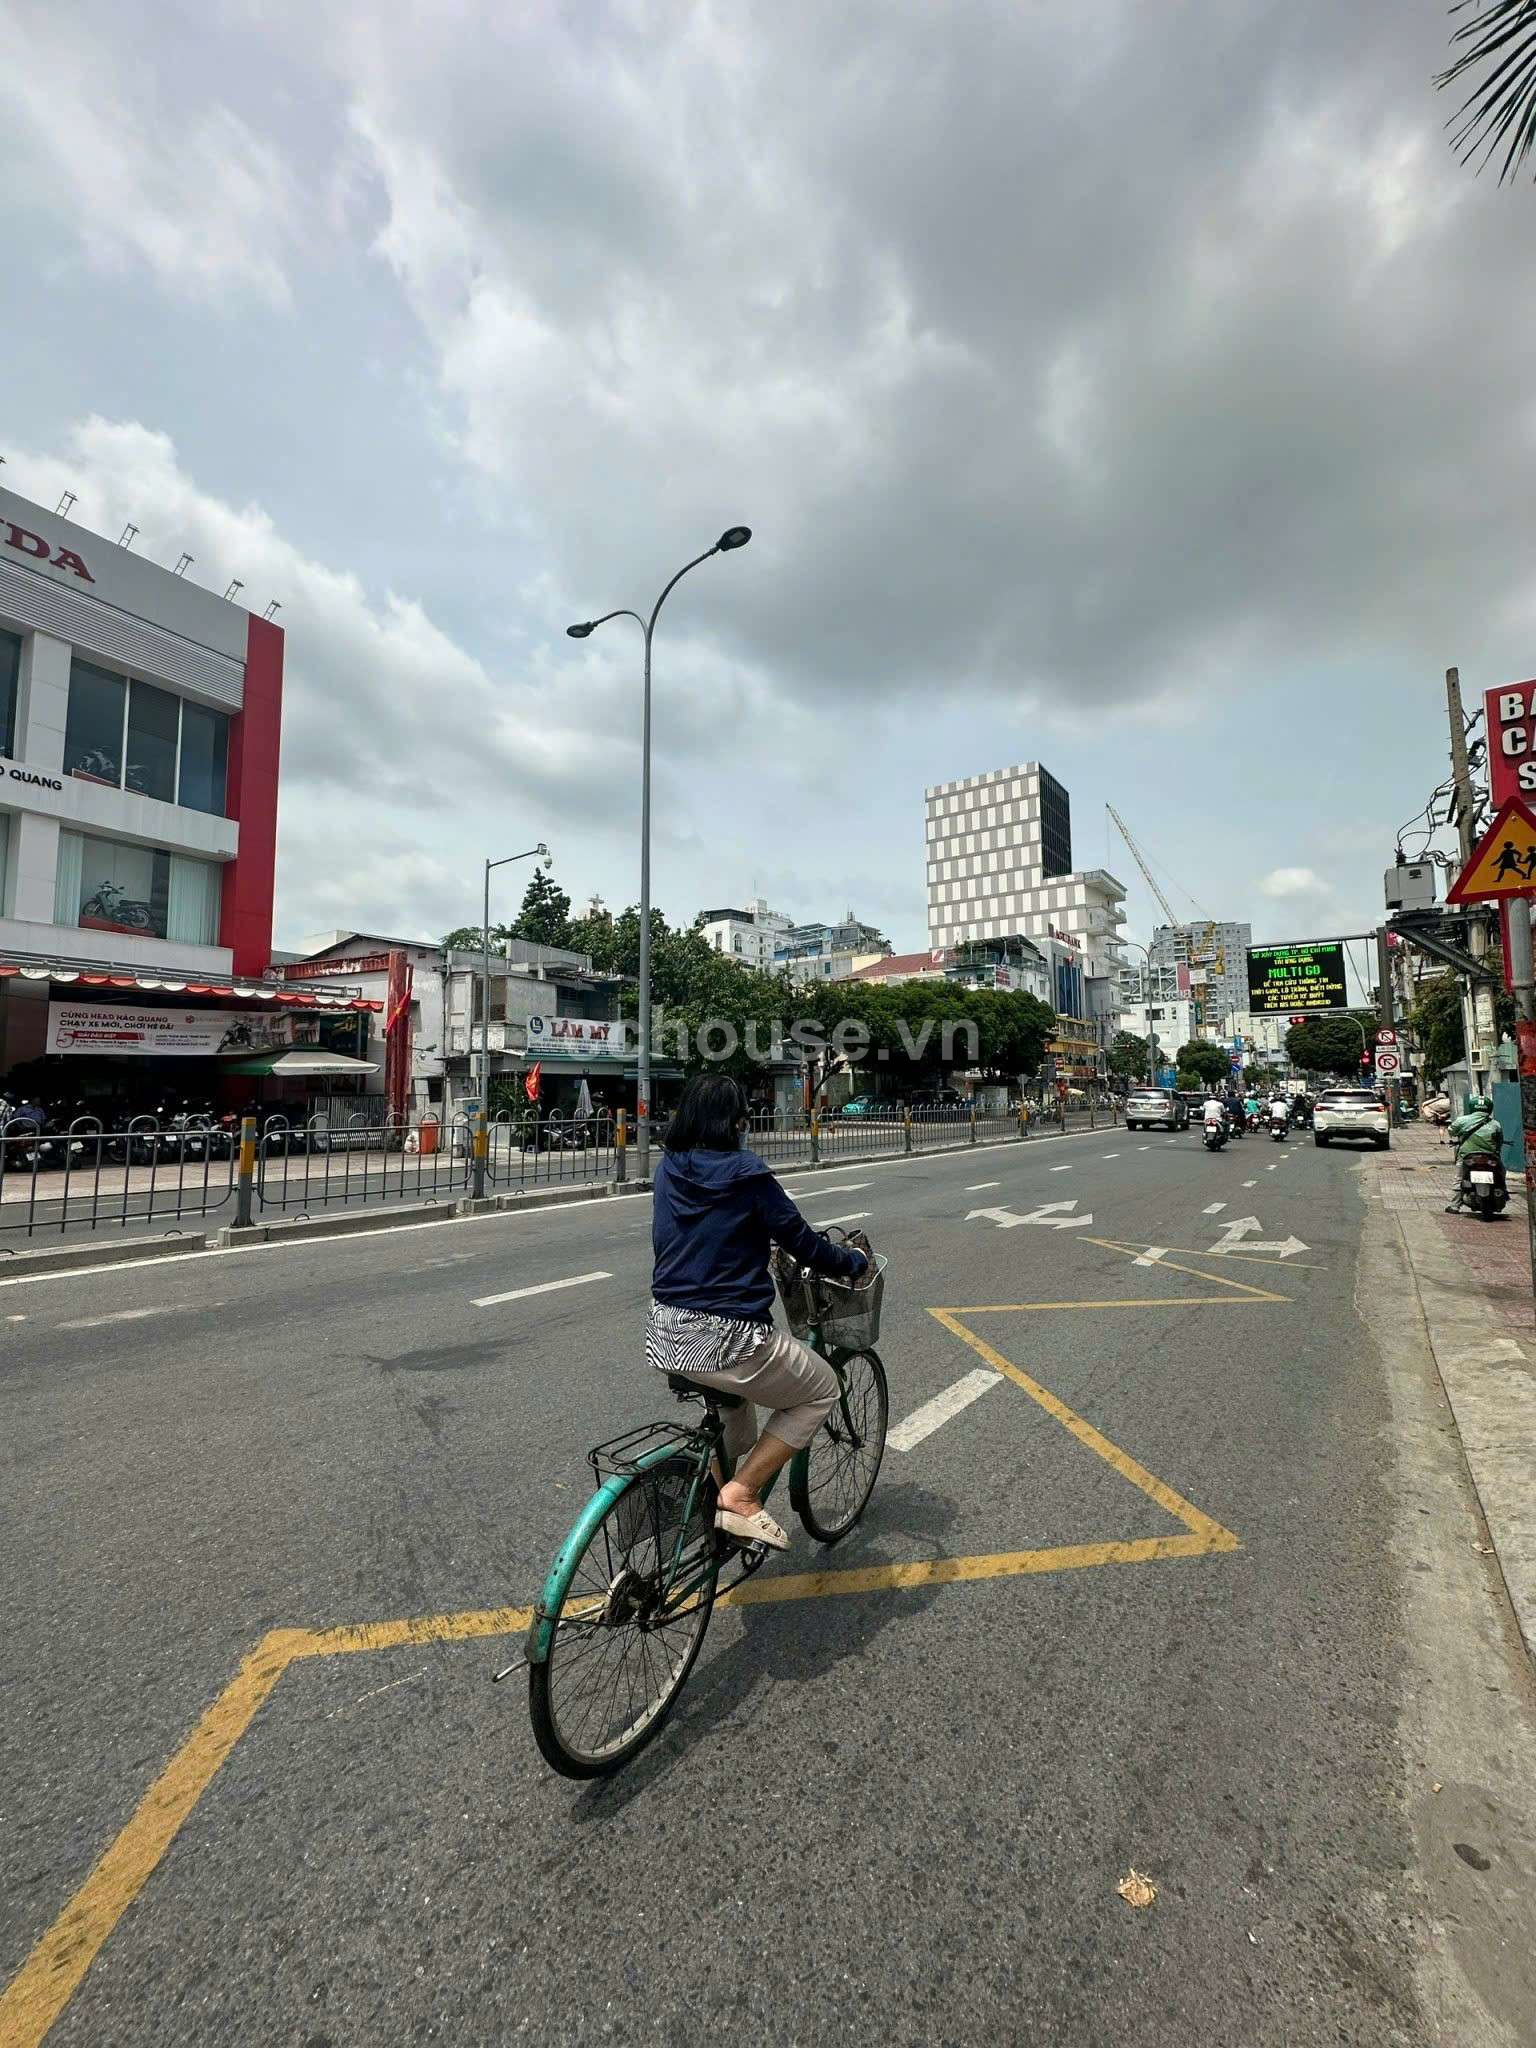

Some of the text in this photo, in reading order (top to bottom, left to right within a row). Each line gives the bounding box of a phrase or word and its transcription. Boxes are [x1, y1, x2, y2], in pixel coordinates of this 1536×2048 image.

[0, 518, 95, 583] DA
[9, 769, 63, 791] QUANG
[1268, 965, 1320, 978] MULTI GO
[60, 1010, 89, 1019] CÙNG
[91, 1012, 115, 1021] HEAD
[137, 1014, 168, 1023] QUANG
[60, 1019, 86, 1028] CHẠY
[551, 1020, 583, 1038] LÂM
[590, 1023, 610, 1040] MỸ
